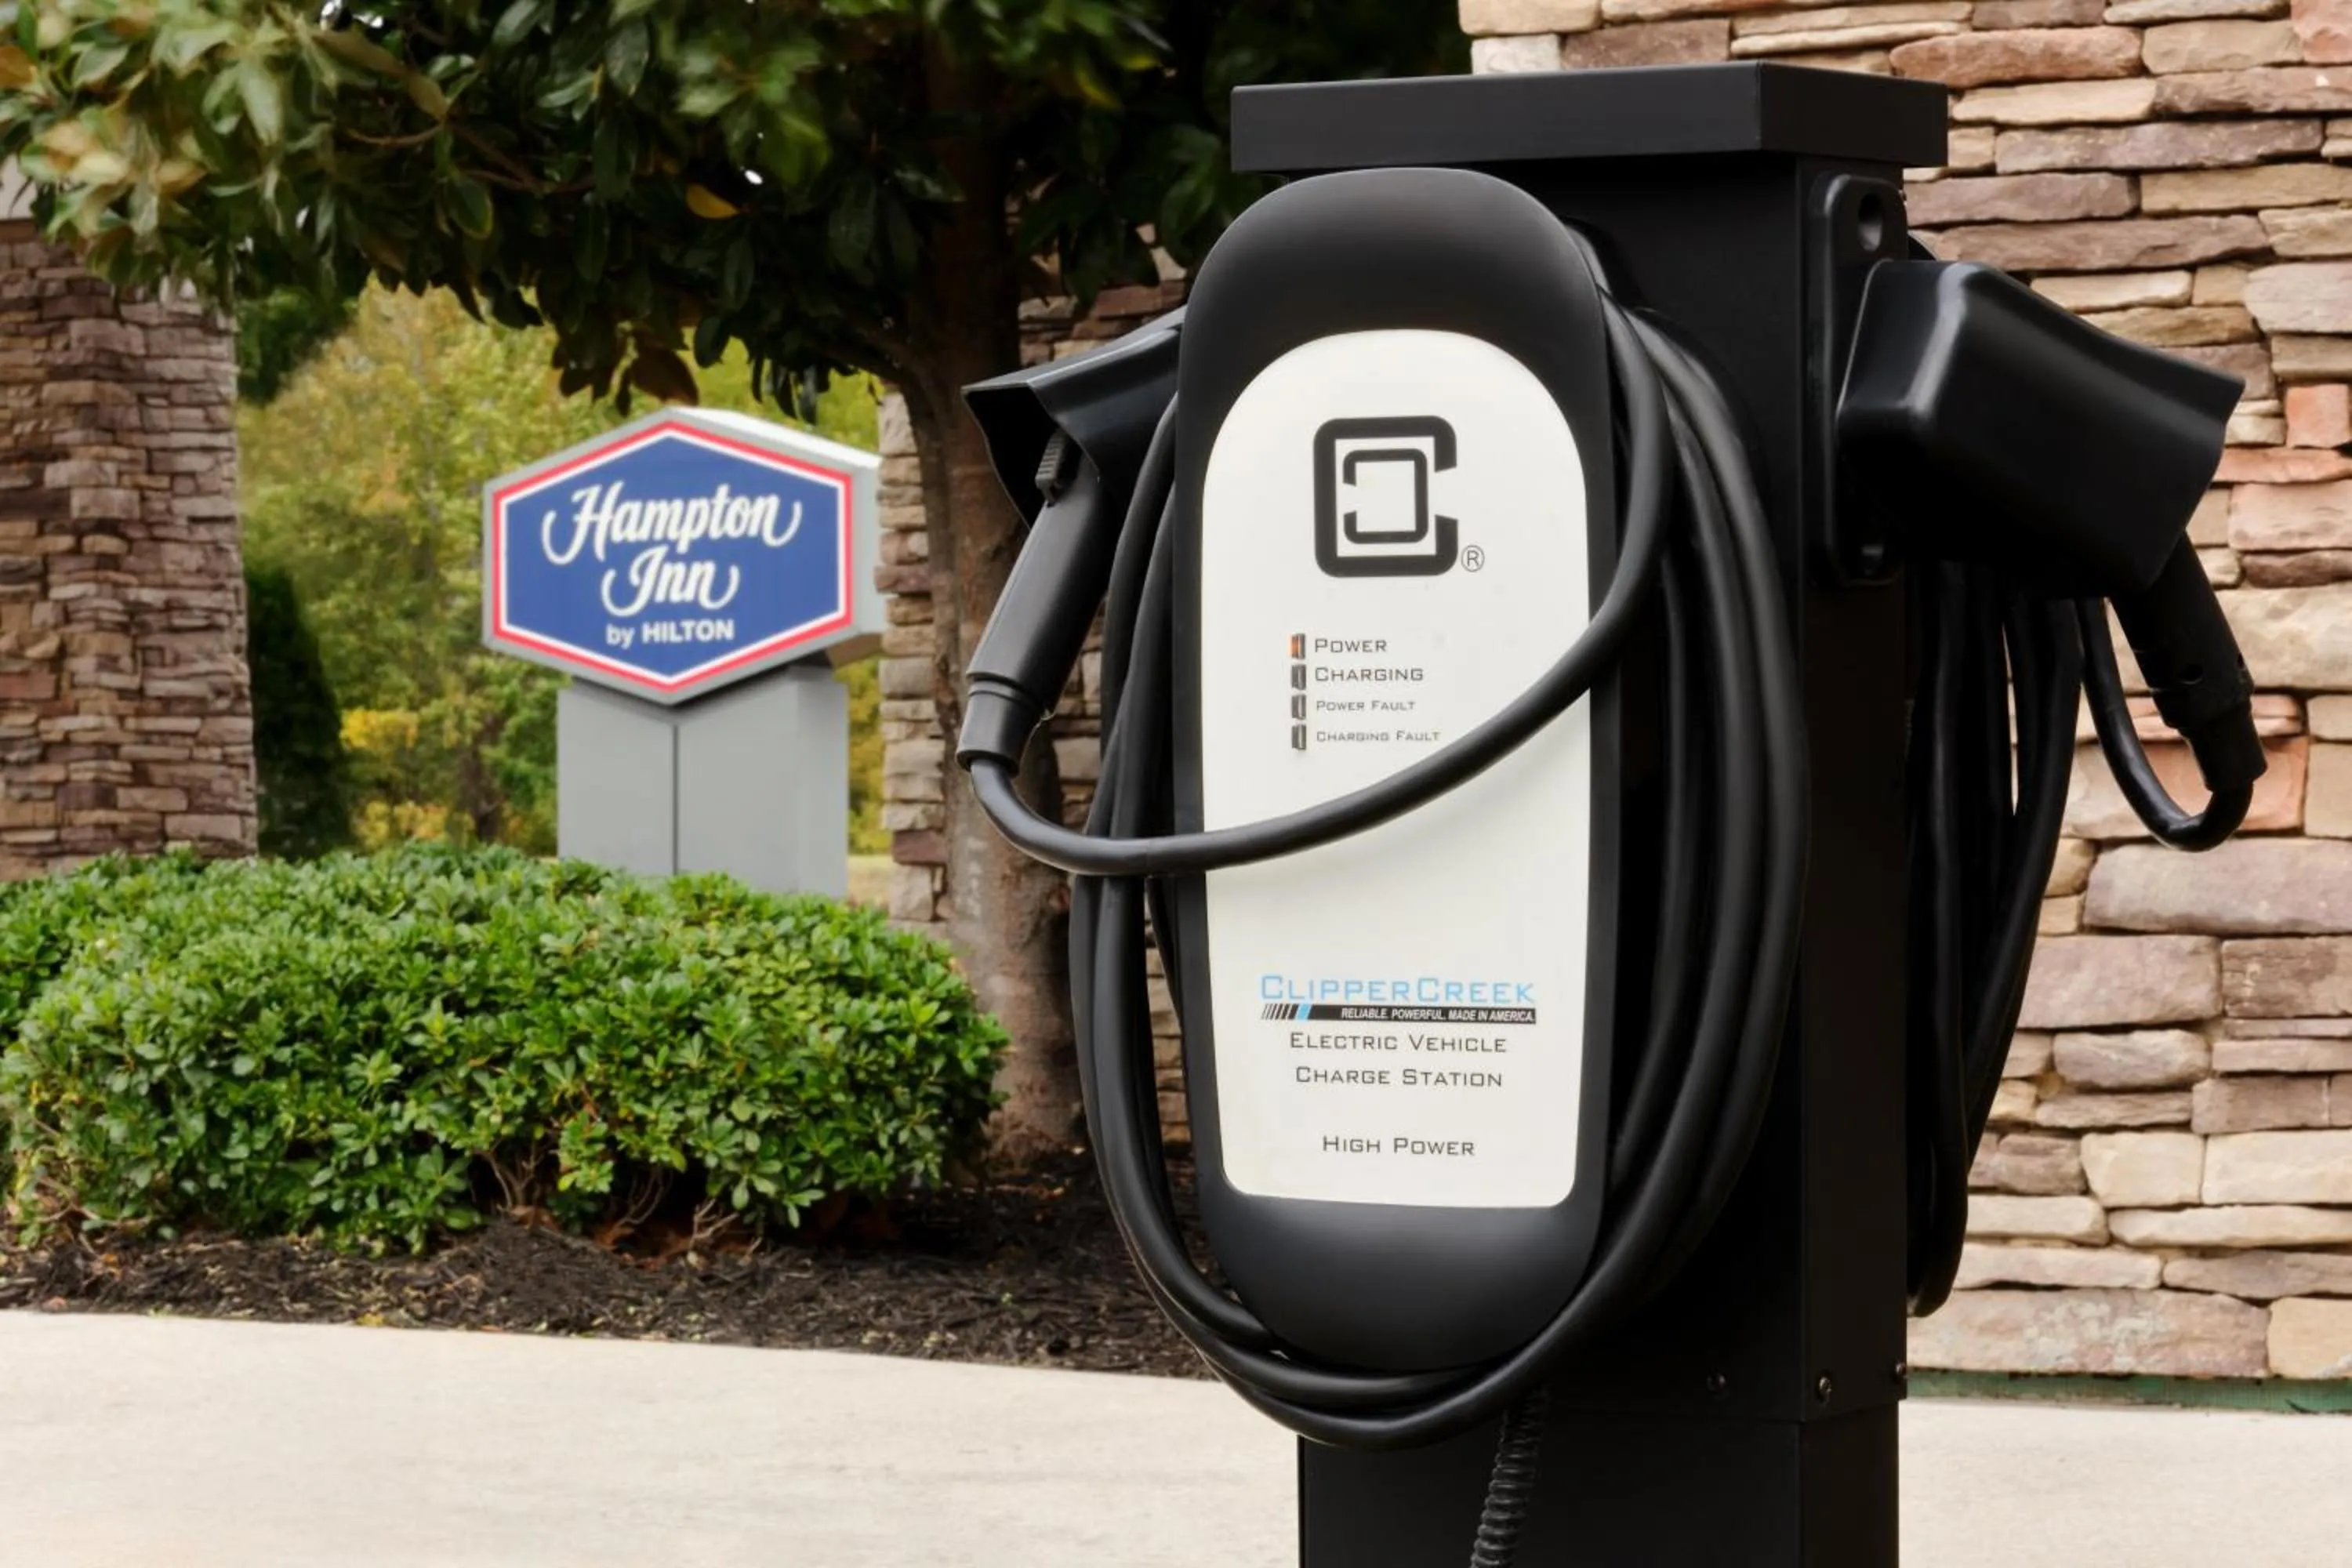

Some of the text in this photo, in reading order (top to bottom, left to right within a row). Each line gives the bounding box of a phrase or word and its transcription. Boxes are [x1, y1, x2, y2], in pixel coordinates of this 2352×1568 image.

[541, 481, 803, 564] Hampton
[601, 544, 740, 616] Inn
[606, 619, 735, 648] by HILTON
[1448, 1009, 1477, 1022] MADE
[1478, 1010, 1489, 1022] IN
